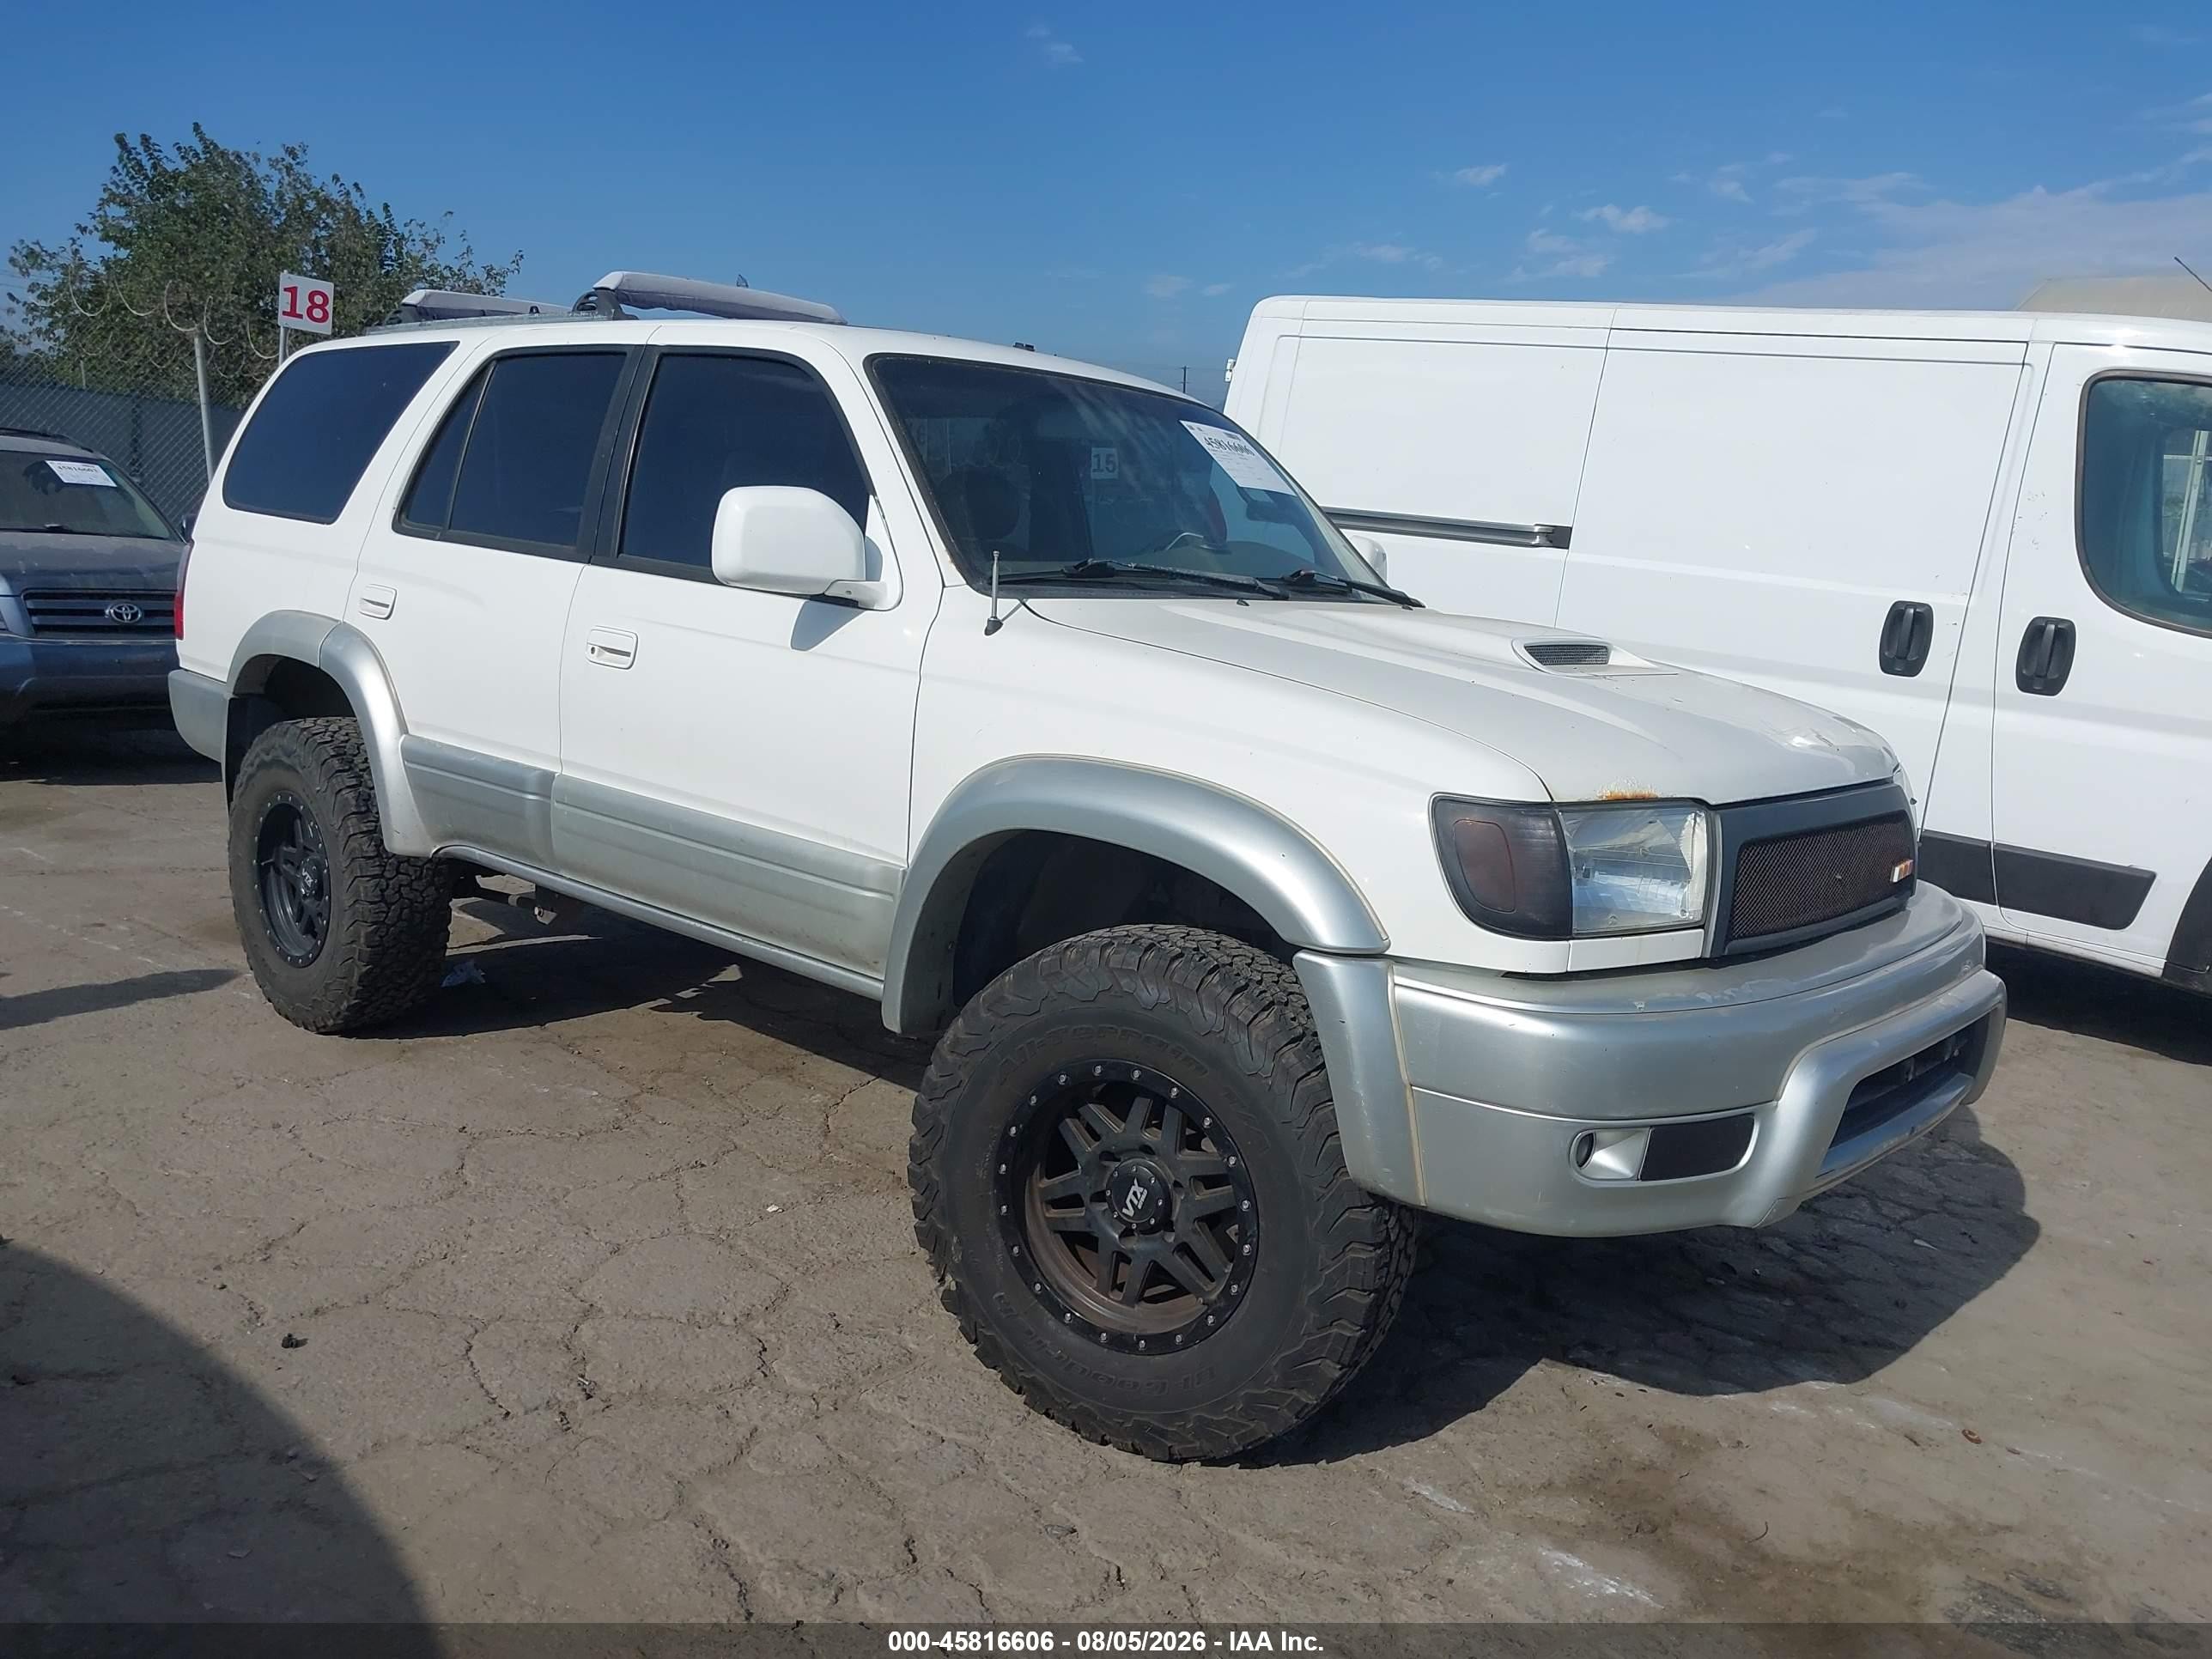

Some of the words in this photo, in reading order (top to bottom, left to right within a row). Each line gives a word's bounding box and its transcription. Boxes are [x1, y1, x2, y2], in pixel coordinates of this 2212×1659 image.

[282, 286, 330, 324] 18
[1203, 436, 1255, 456] 45816606
[1091, 453, 1117, 473] 15
[1121, 1176, 1144, 1218] VTX
